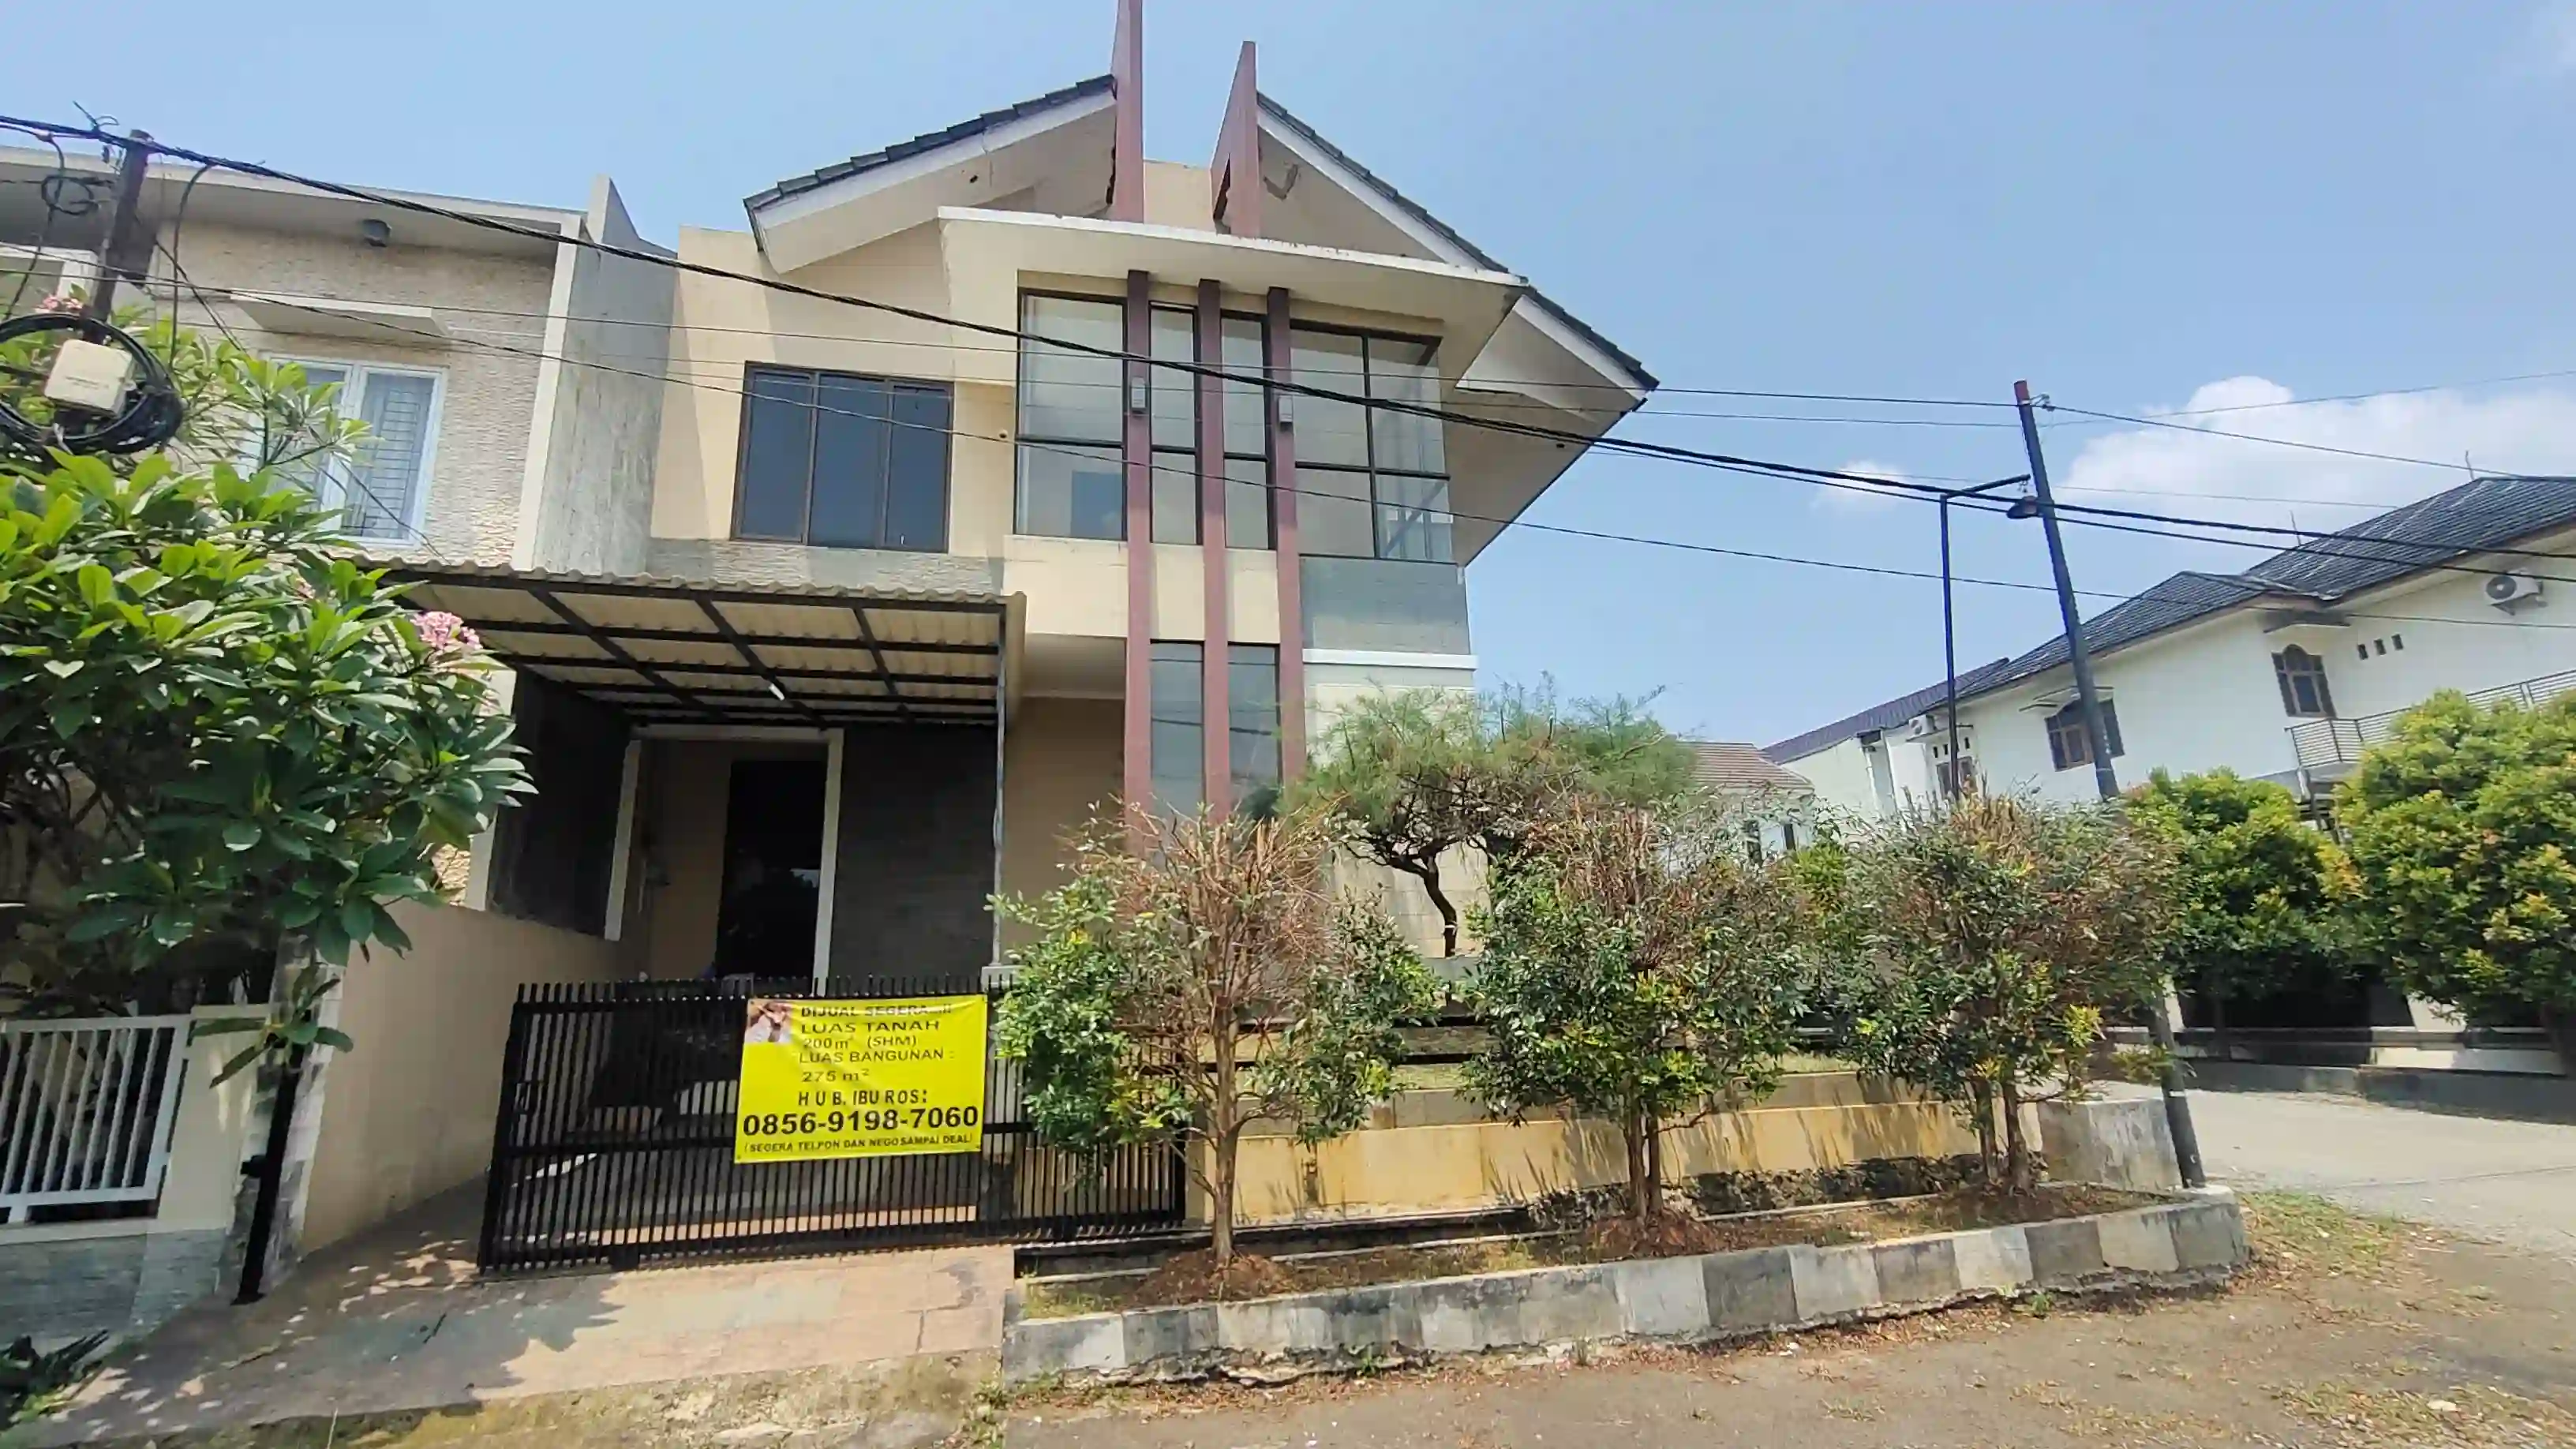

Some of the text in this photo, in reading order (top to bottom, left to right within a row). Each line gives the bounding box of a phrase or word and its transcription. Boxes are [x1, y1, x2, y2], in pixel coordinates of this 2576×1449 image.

[800, 1006, 859, 1017] DIJUAL
[800, 1020, 940, 1034] LUAS TANAH
[867, 1035, 917, 1049] (SHM)
[799, 1051, 844, 1064] LUAS
[849, 1048, 945, 1063] BANGUNAN
[802, 1070, 837, 1082] 275
[853, 1090, 880, 1105] IBU
[884, 1088, 928, 1105] ROS:
[743, 1105, 979, 1136] 0856-9198-7060
[844, 1139, 866, 1149] DAN
